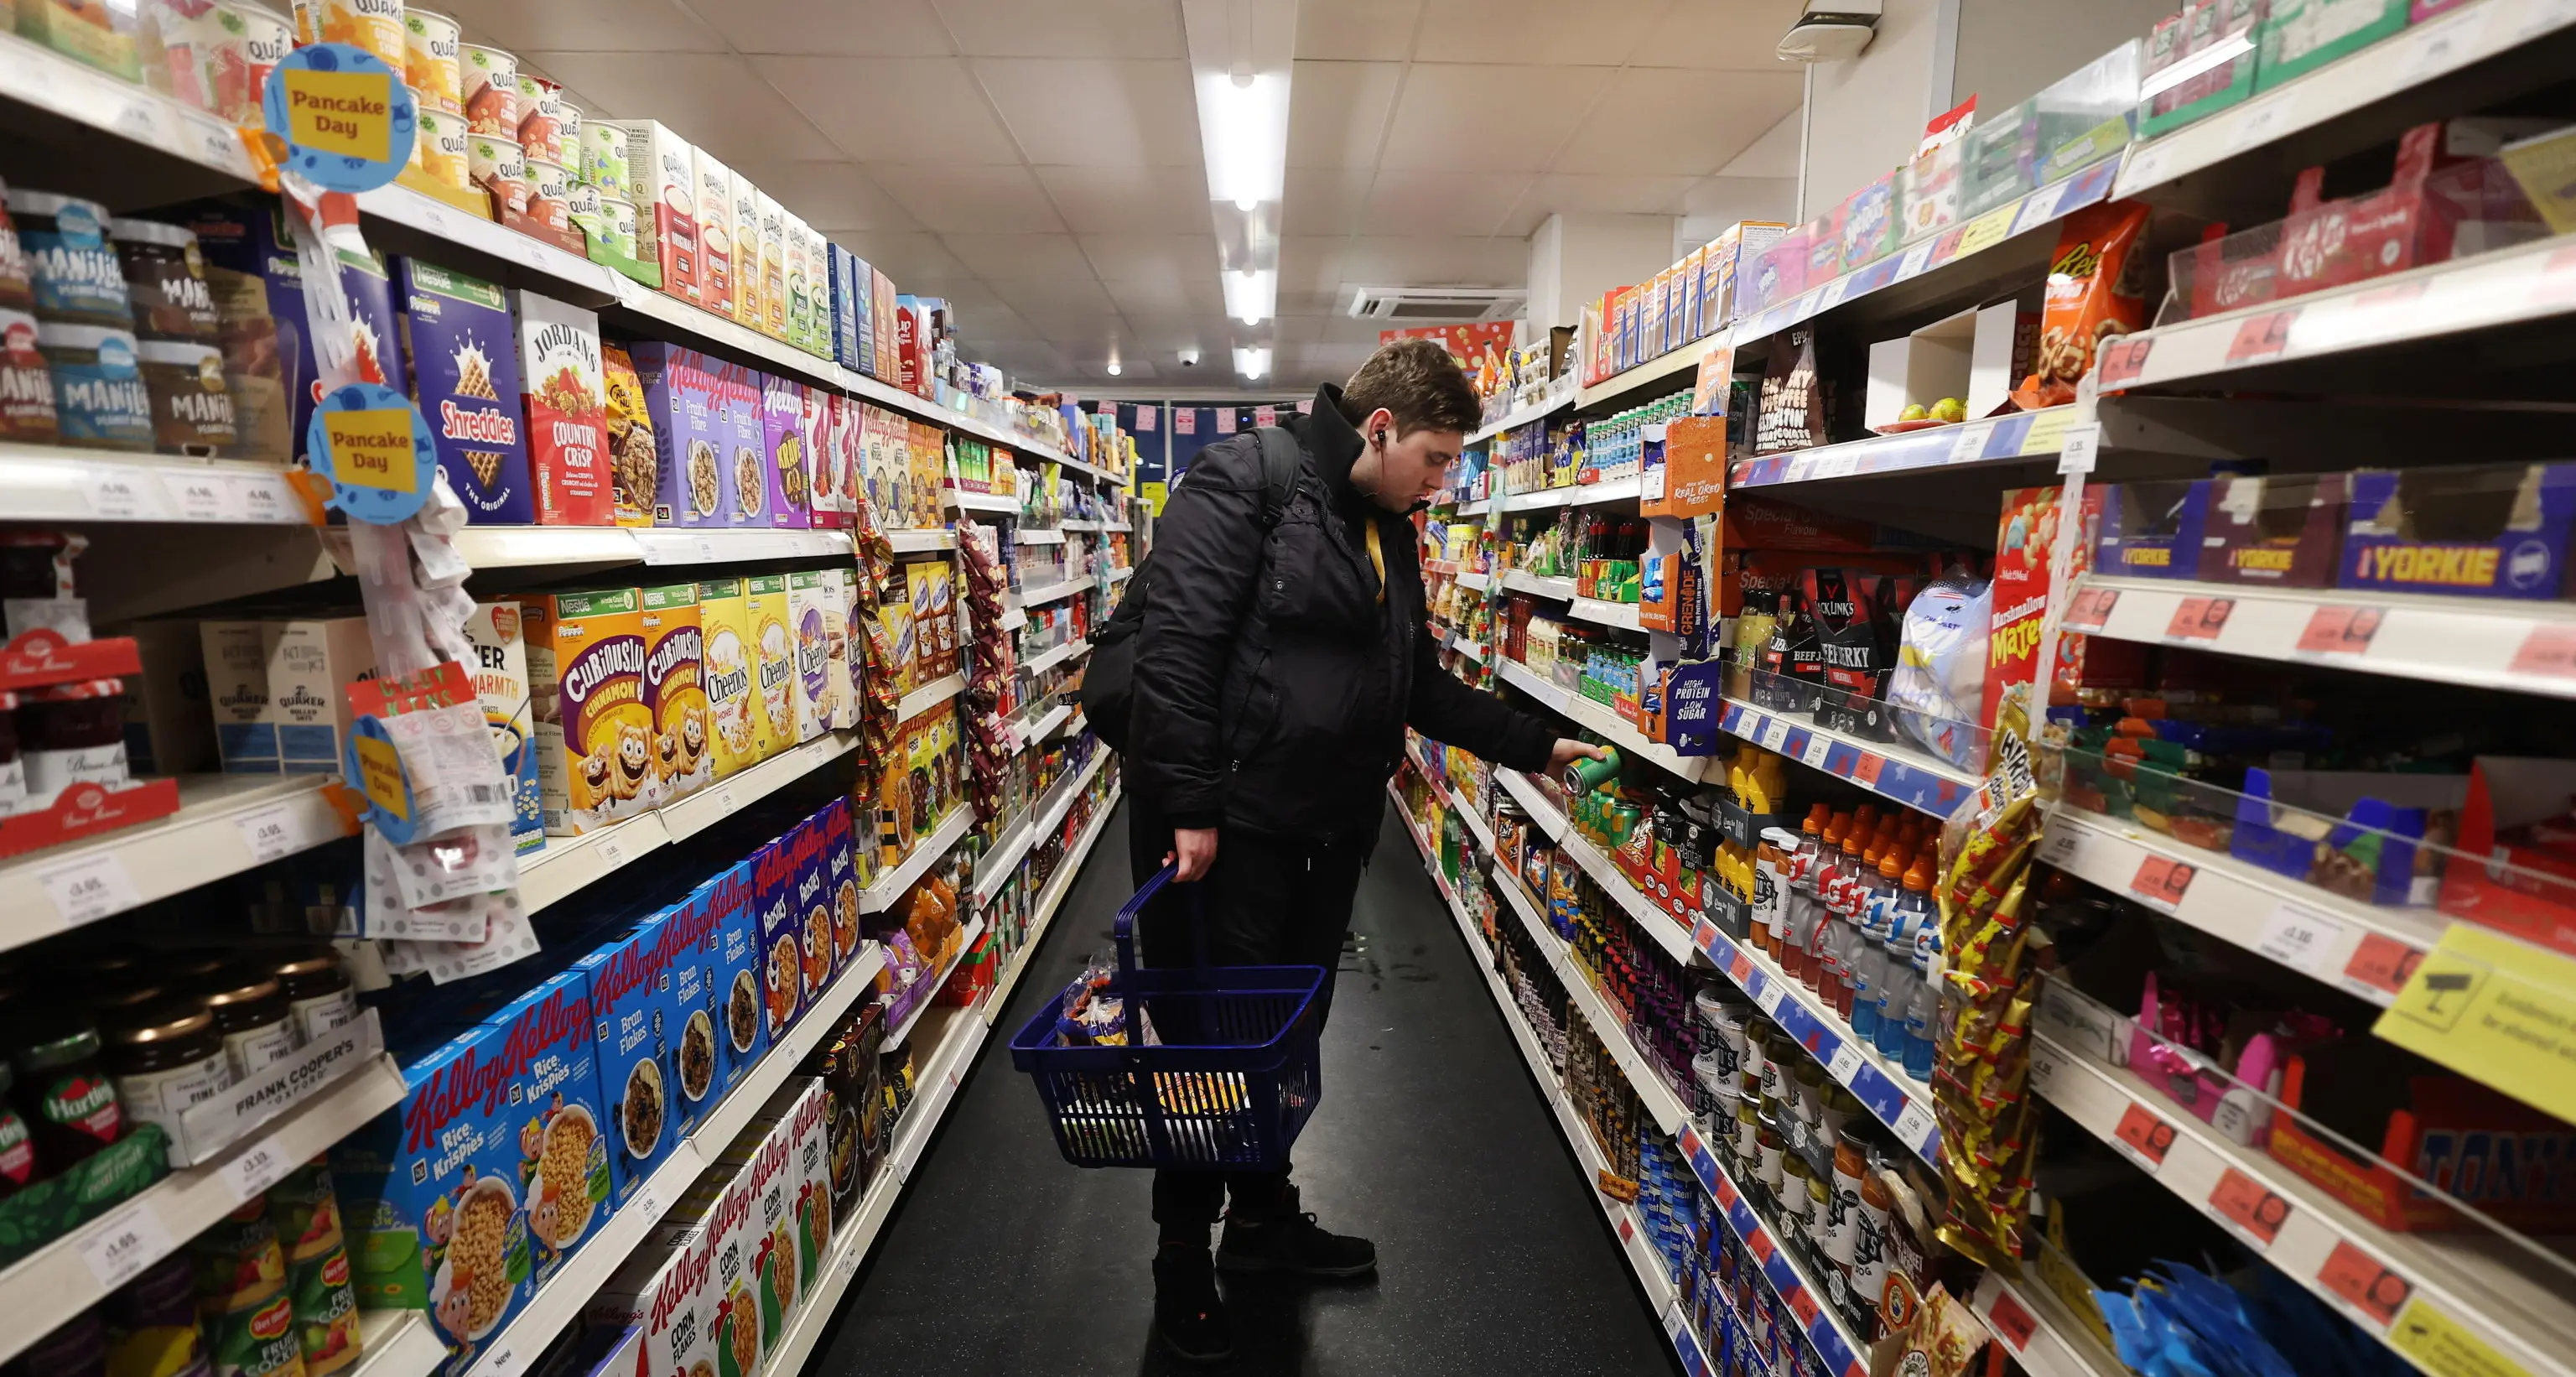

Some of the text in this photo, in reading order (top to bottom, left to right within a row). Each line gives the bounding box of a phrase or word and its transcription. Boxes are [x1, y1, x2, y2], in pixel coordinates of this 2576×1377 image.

[293, 90, 385, 116] Pancake
[315, 116, 358, 139] Day
[662, 154, 690, 181] QUAKER
[704, 173, 726, 196] QUAKER
[737, 199, 758, 221] QUAKER
[763, 216, 784, 237] QUAKER
[533, 323, 597, 373] JORDANS
[441, 399, 516, 445] Shreddies
[690, 416, 708, 432] Fibre
[333, 431, 409, 451] Pancake
[553, 420, 597, 450] COUNTRY
[352, 452, 389, 475] Day
[776, 436, 802, 470] KRAVE
[465, 481, 511, 512] THE ORIGINAL
[1674, 483, 1721, 499] REAL OREO
[1744, 504, 1798, 527] Special
[1784, 523, 1819, 536] Flavour
[2124, 548, 2171, 567] YORKIE
[2236, 548, 2293, 572] YORKIE
[2374, 545, 2503, 586] YORKIE
[560, 598, 592, 614] Nestlé
[644, 592, 666, 606] Nestlé
[1831, 601, 1854, 616] LINK'S
[1992, 595, 2047, 631] Marshmallow
[1991, 616, 2046, 668] Mate
[799, 641, 828, 675] Cheerios
[1794, 651, 1815, 662] BEEF
[661, 668, 695, 700] CINNAMON
[761, 655, 790, 690] Cheerios
[1684, 679, 1703, 688] HIGH
[708, 667, 748, 704] Cheerios
[1675, 687, 1711, 699] PROTEIN
[219, 694, 269, 708] QUAKER
[279, 695, 326, 709] QUAKER
[585, 681, 636, 719] CINNAMON
[767, 692, 780, 705] HONEY
[1684, 700, 1703, 710] LOW
[717, 706, 734, 722] HONEY
[1677, 708, 1706, 720] SUGAR
[373, 776, 393, 798] Day
[1680, 842, 1702, 865] Plantain
[1685, 860, 1696, 870] CHIPS
[799, 866, 820, 908] FROSTIES
[763, 892, 787, 938] FROSTIES
[726, 928, 742, 947] Bran
[725, 943, 745, 964] Flakes
[679, 965, 697, 985] Bran
[678, 979, 700, 1006] Flakes
[621, 1010, 642, 1034] Bran
[620, 1026, 647, 1057] Flakes
[235, 1039, 356, 1118] FRANK COOPER'S
[533, 1054, 558, 1079] Rice
[441, 1122, 470, 1153] Rice
[802, 1136, 818, 1163] CORN
[803, 1152, 818, 1177] FLAKES
[764, 1183, 781, 1215] CORN
[765, 1200, 782, 1229] FLAKES
[719, 1238, 739, 1276] CORN
[722, 1256, 740, 1291] FLAKES
[672, 1307, 694, 1348] CORN
[493, 1348, 512, 1369] New
[673, 1328, 696, 1365] FLAKES
